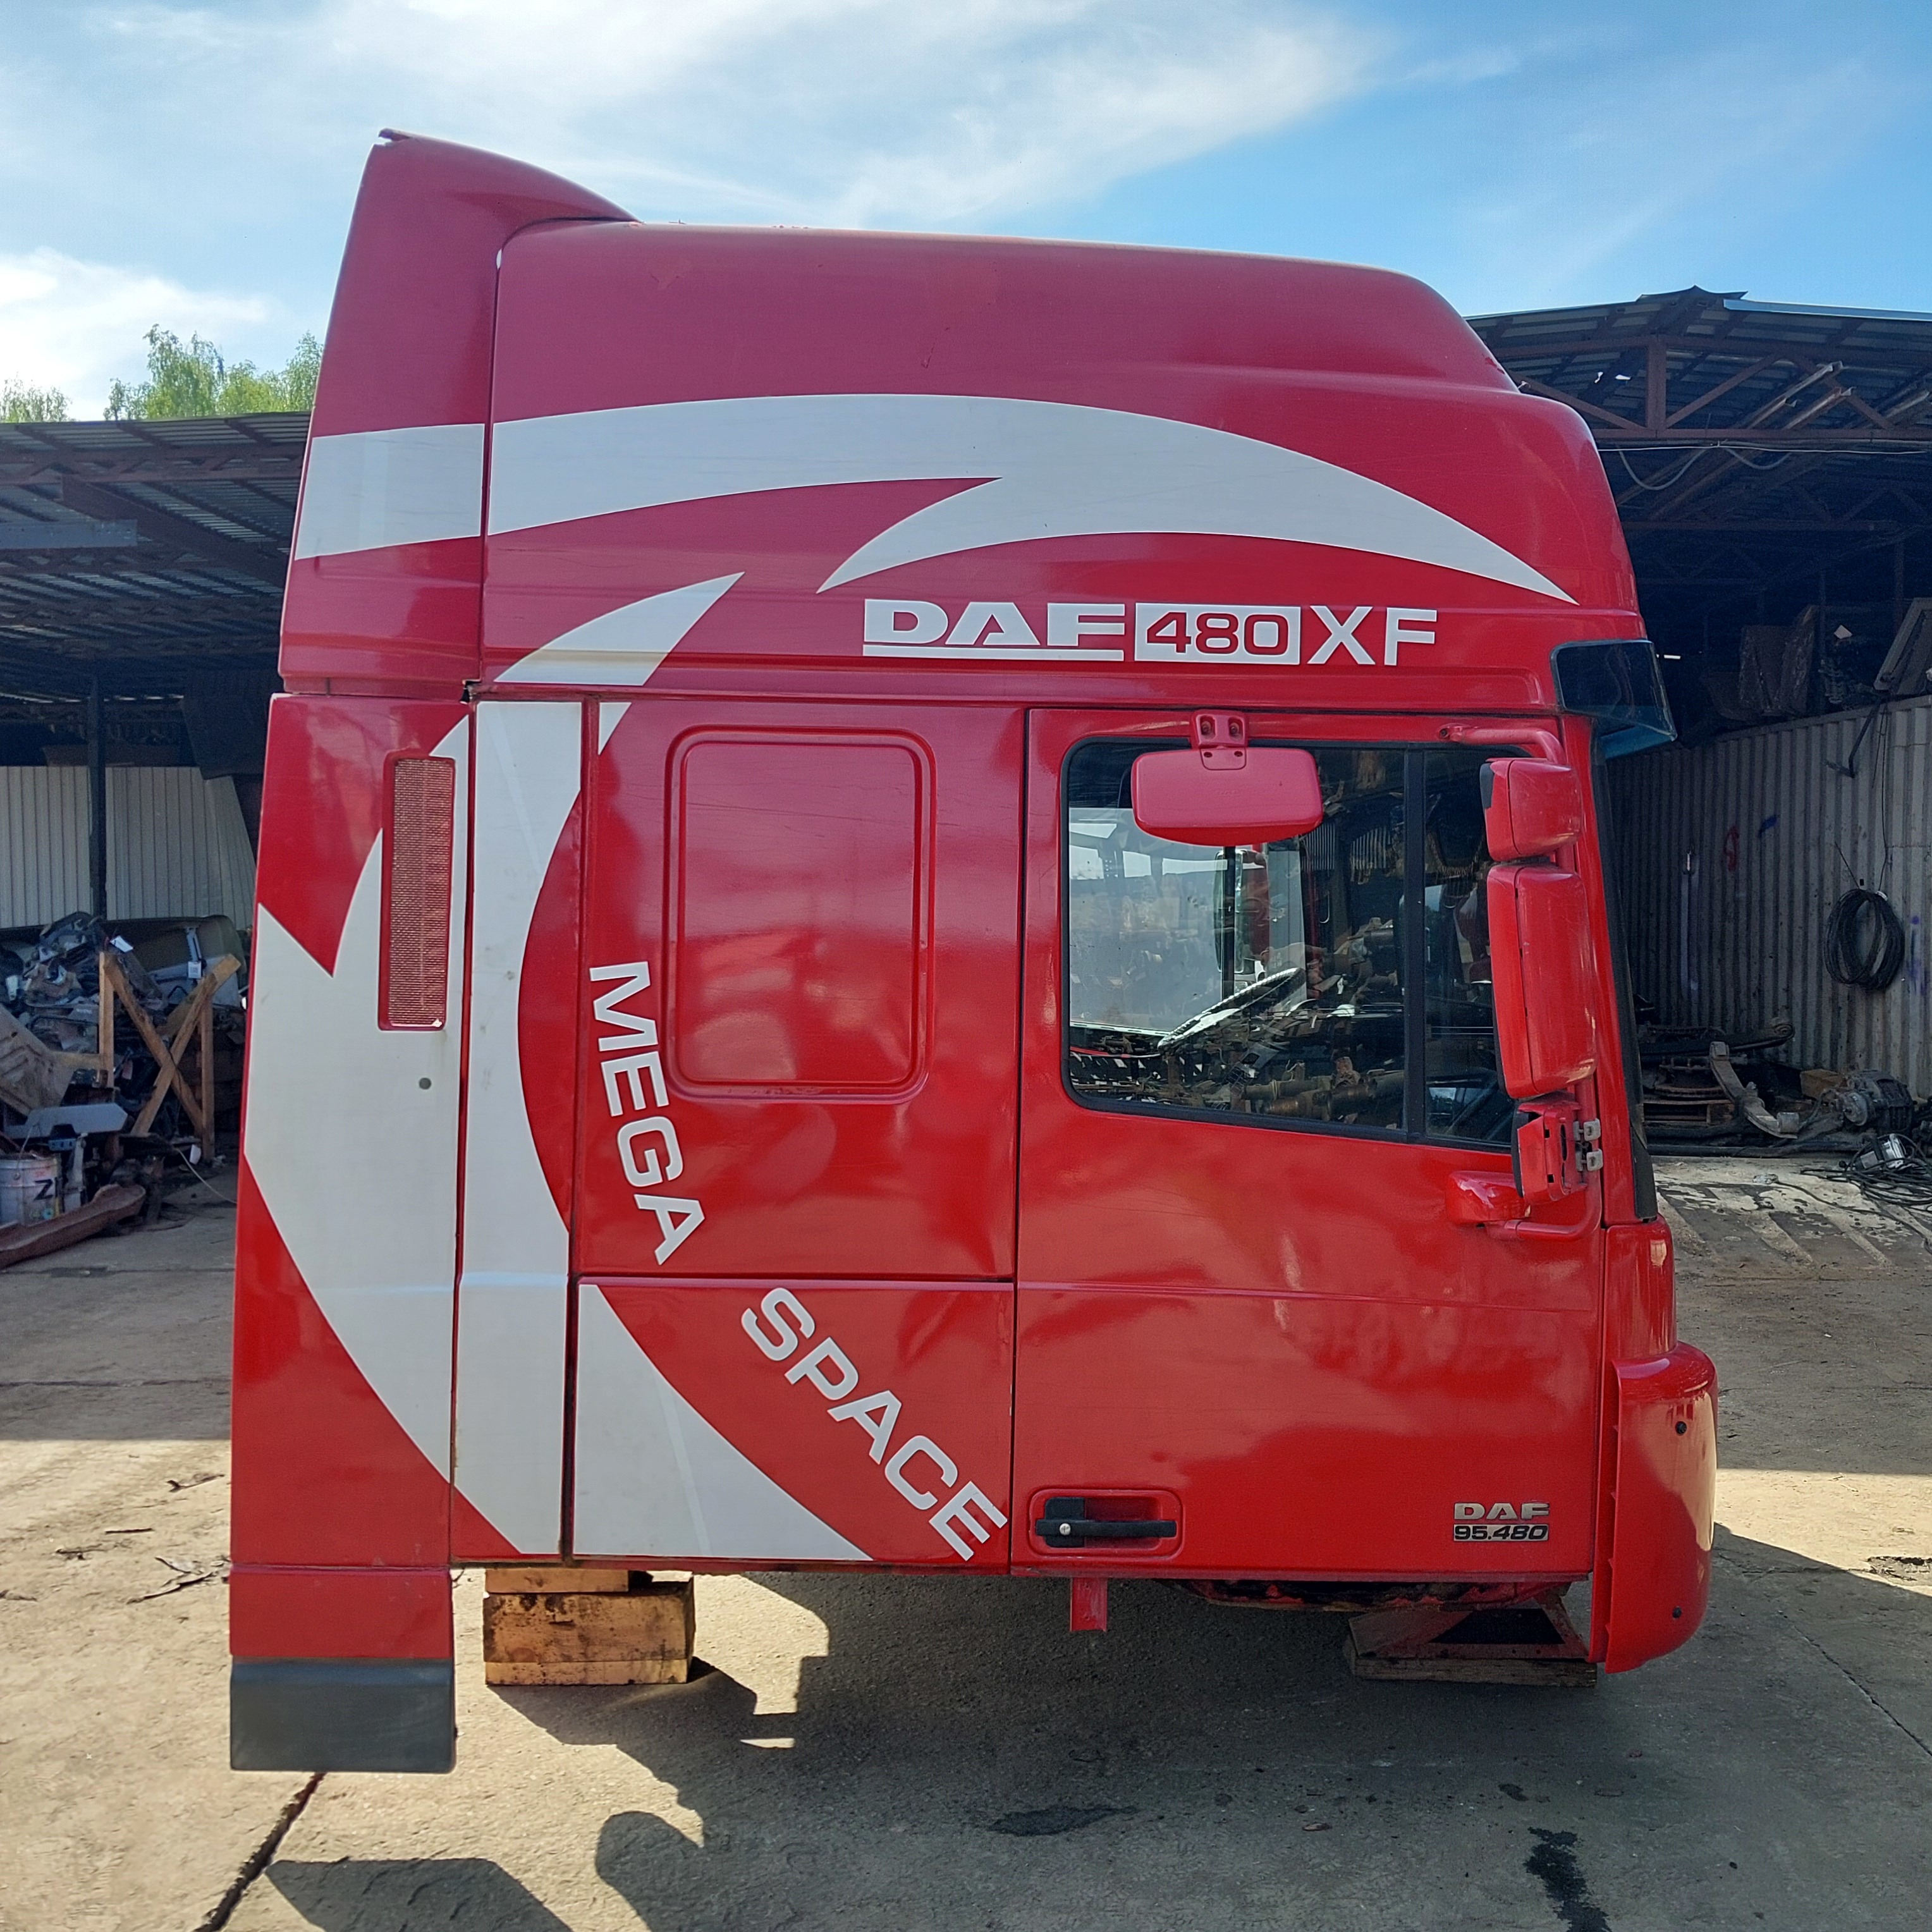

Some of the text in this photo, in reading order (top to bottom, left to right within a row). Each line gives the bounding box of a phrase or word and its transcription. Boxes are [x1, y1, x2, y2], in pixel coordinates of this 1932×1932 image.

[863, 599, 1438, 666] DAF 480 XF
[589, 961, 1008, 1562] MEGA SPACE
[1454, 1503, 1550, 1520] DAF
[1454, 1525, 1548, 1540] 95.480
